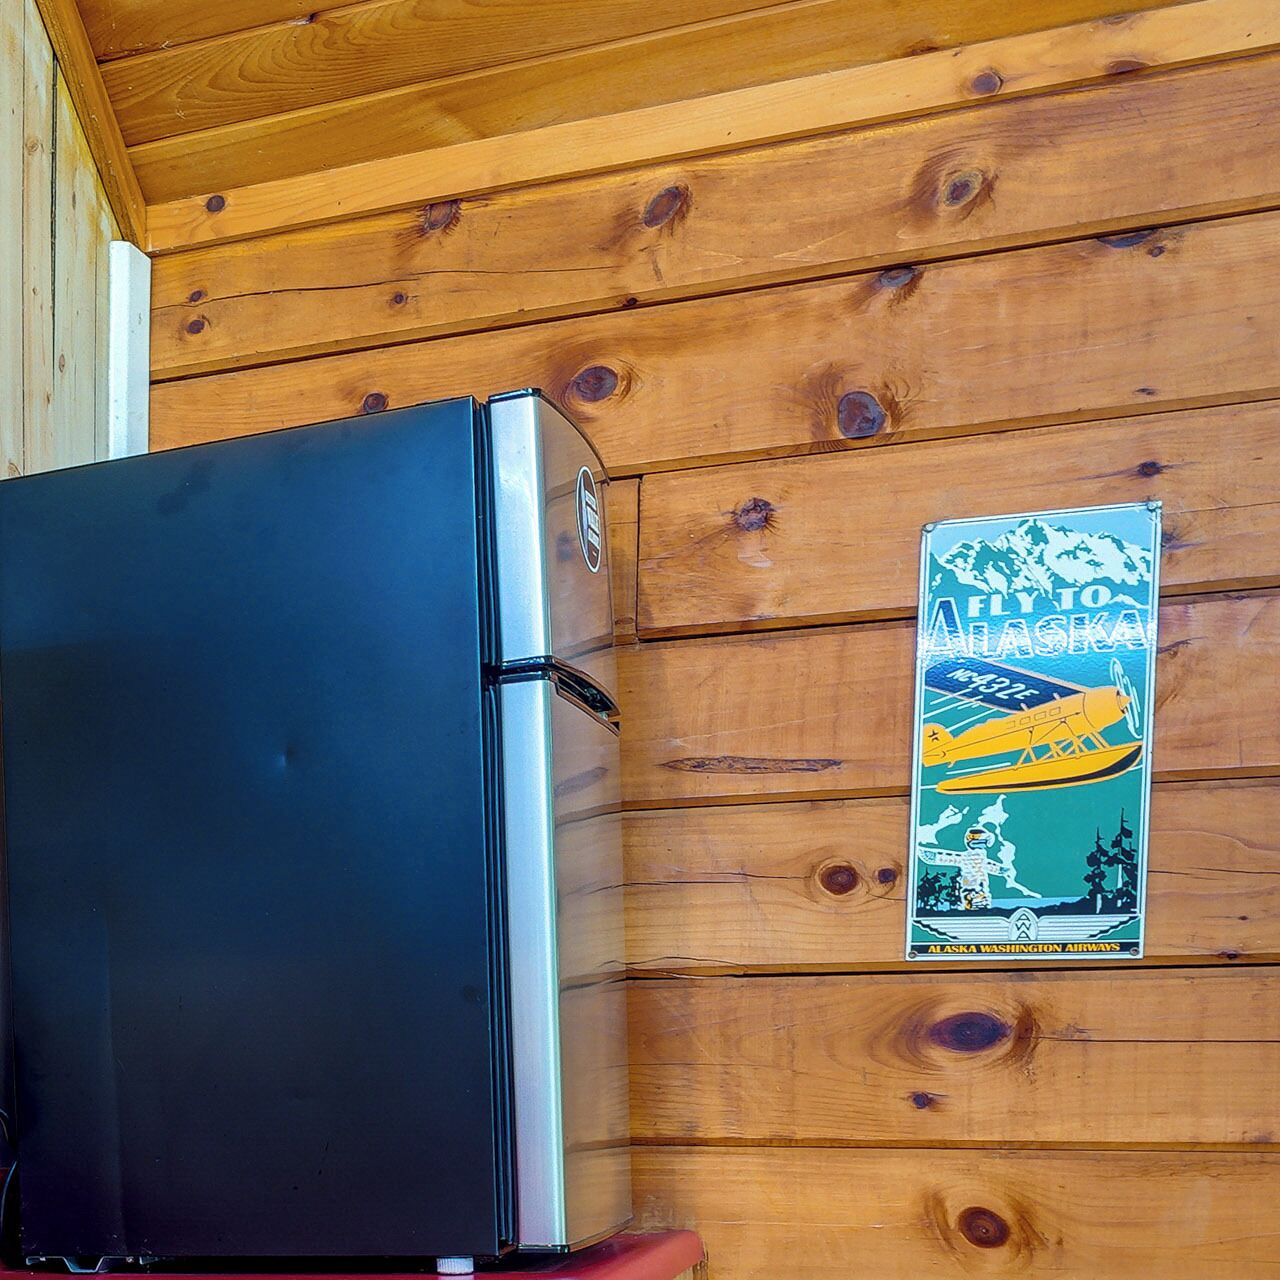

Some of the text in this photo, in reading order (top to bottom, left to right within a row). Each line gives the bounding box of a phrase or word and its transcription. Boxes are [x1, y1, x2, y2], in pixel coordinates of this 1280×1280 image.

[967, 584, 1113, 618] FLY TO
[925, 597, 1149, 662] ALASKA
[946, 668, 1040, 701] NC432E
[928, 942, 1121, 954] ALASKA WASHINGTON AIRWAYS
